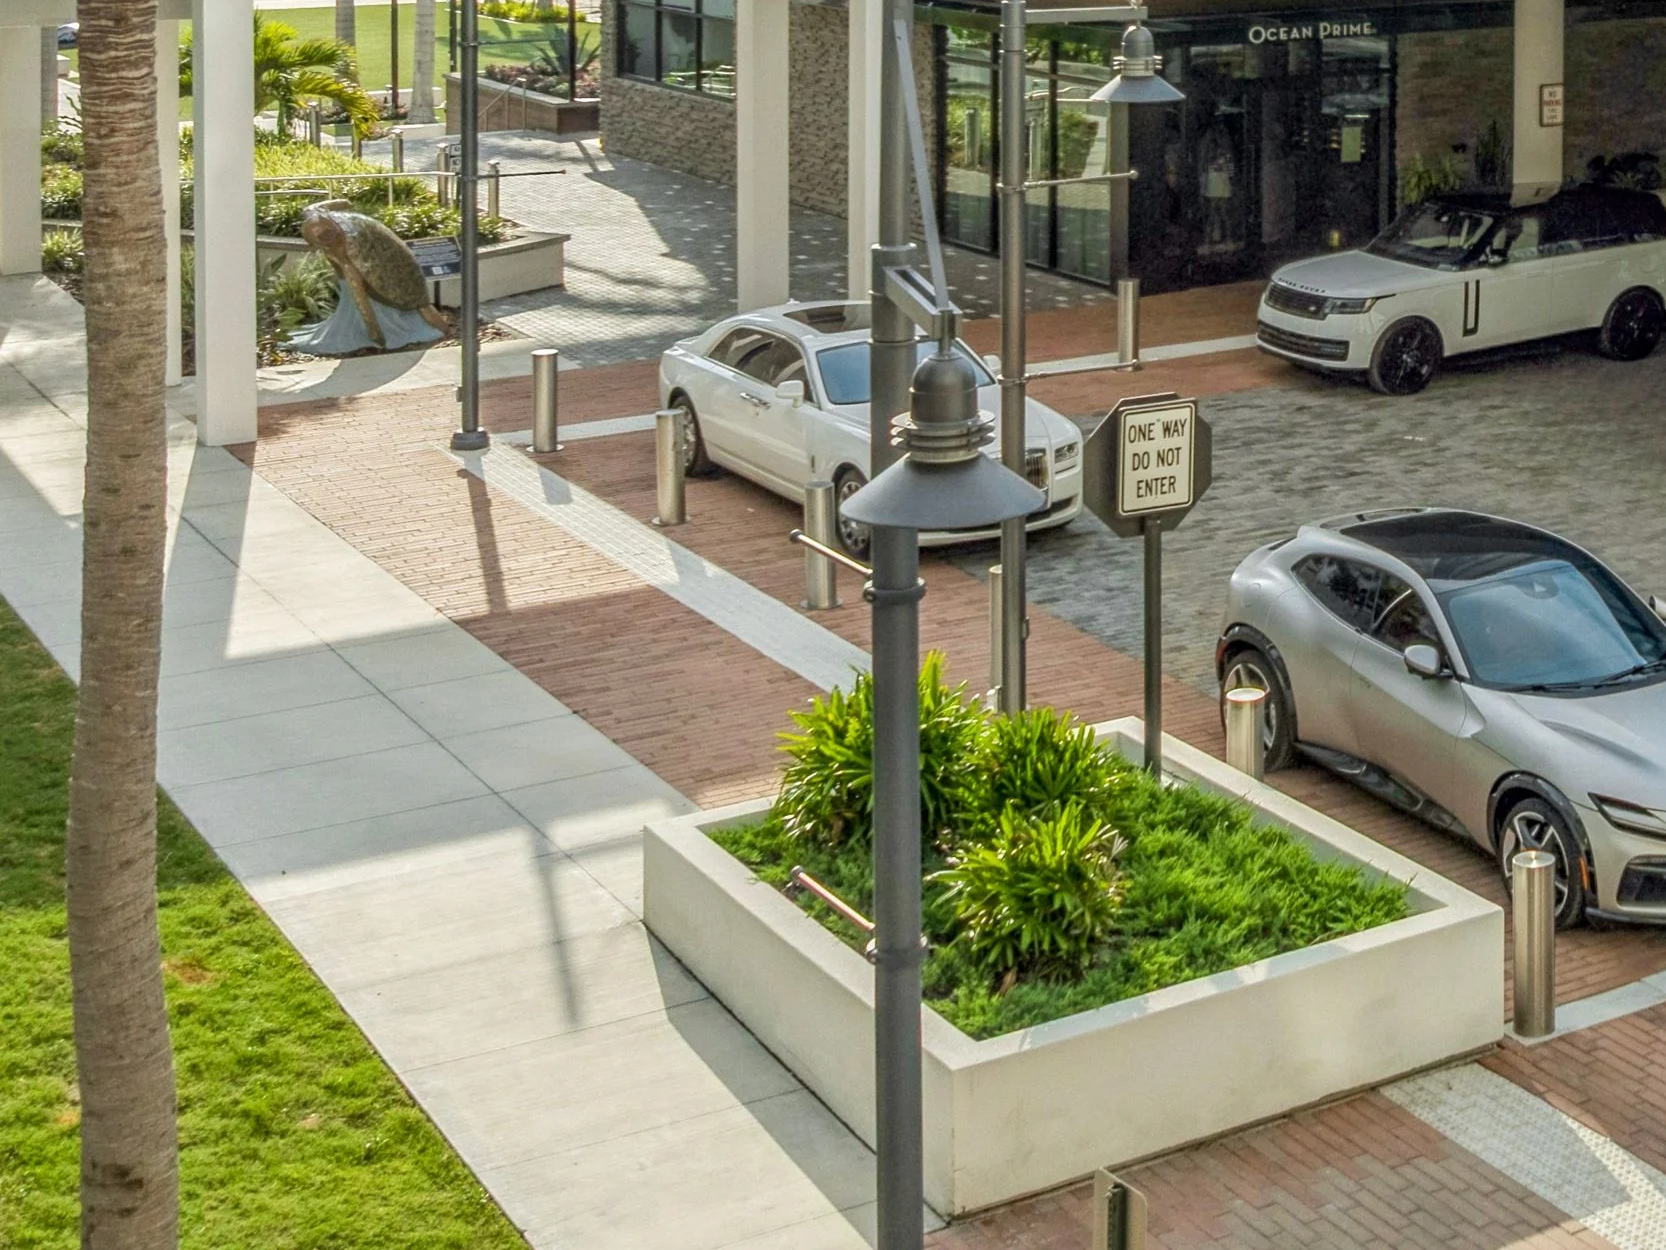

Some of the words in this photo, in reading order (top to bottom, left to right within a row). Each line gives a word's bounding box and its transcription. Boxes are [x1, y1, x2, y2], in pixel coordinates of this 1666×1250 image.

[1248, 26, 1313, 45] OCEAN
[1318, 21, 1373, 39] PRIME
[1128, 422, 1156, 444] ONE
[1162, 417, 1188, 440] WAY
[1132, 451, 1151, 472] DO
[1157, 446, 1183, 469] NOT
[1136, 475, 1177, 499] ENTER
